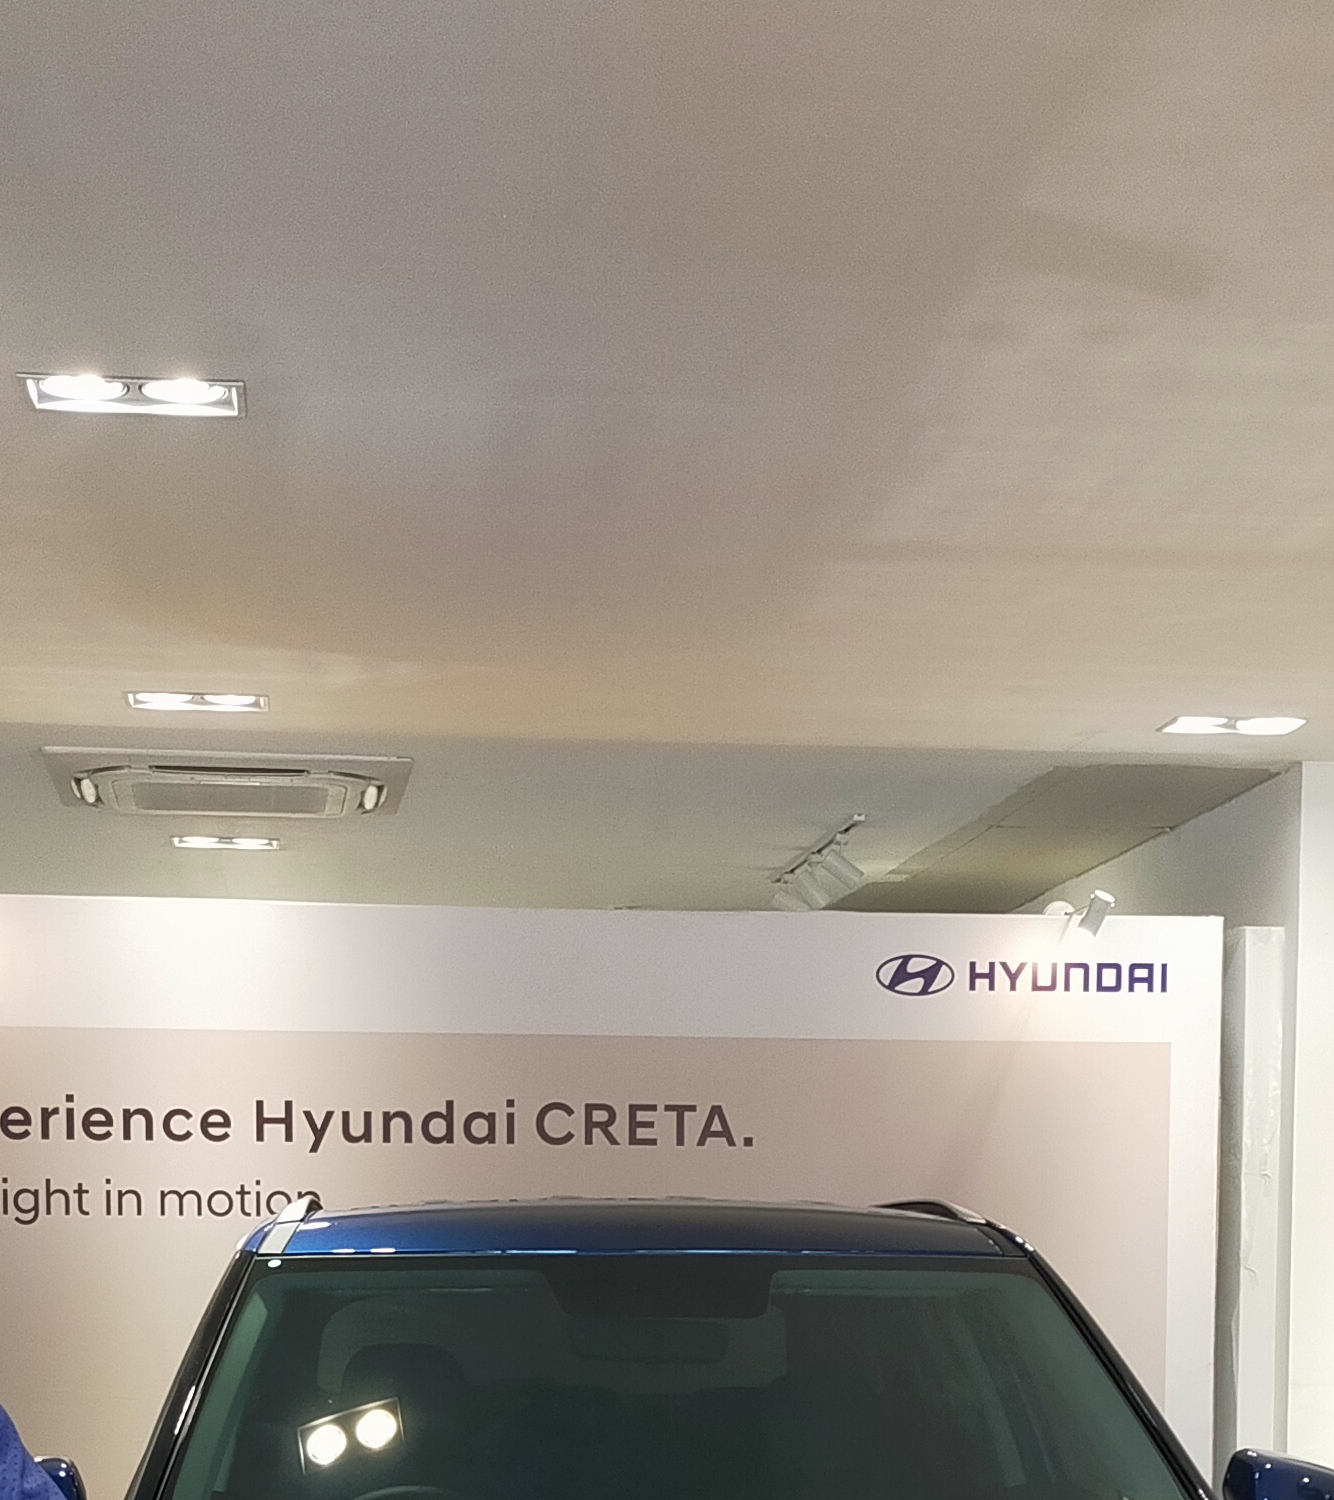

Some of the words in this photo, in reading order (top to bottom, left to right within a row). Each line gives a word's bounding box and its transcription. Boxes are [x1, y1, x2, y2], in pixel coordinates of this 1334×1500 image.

[968, 960, 1168, 993] HYUNDAI
[254, 1099, 516, 1154] Hyundai
[534, 1102, 755, 1148] CRETA.
[104, 1178, 142, 1216] in
